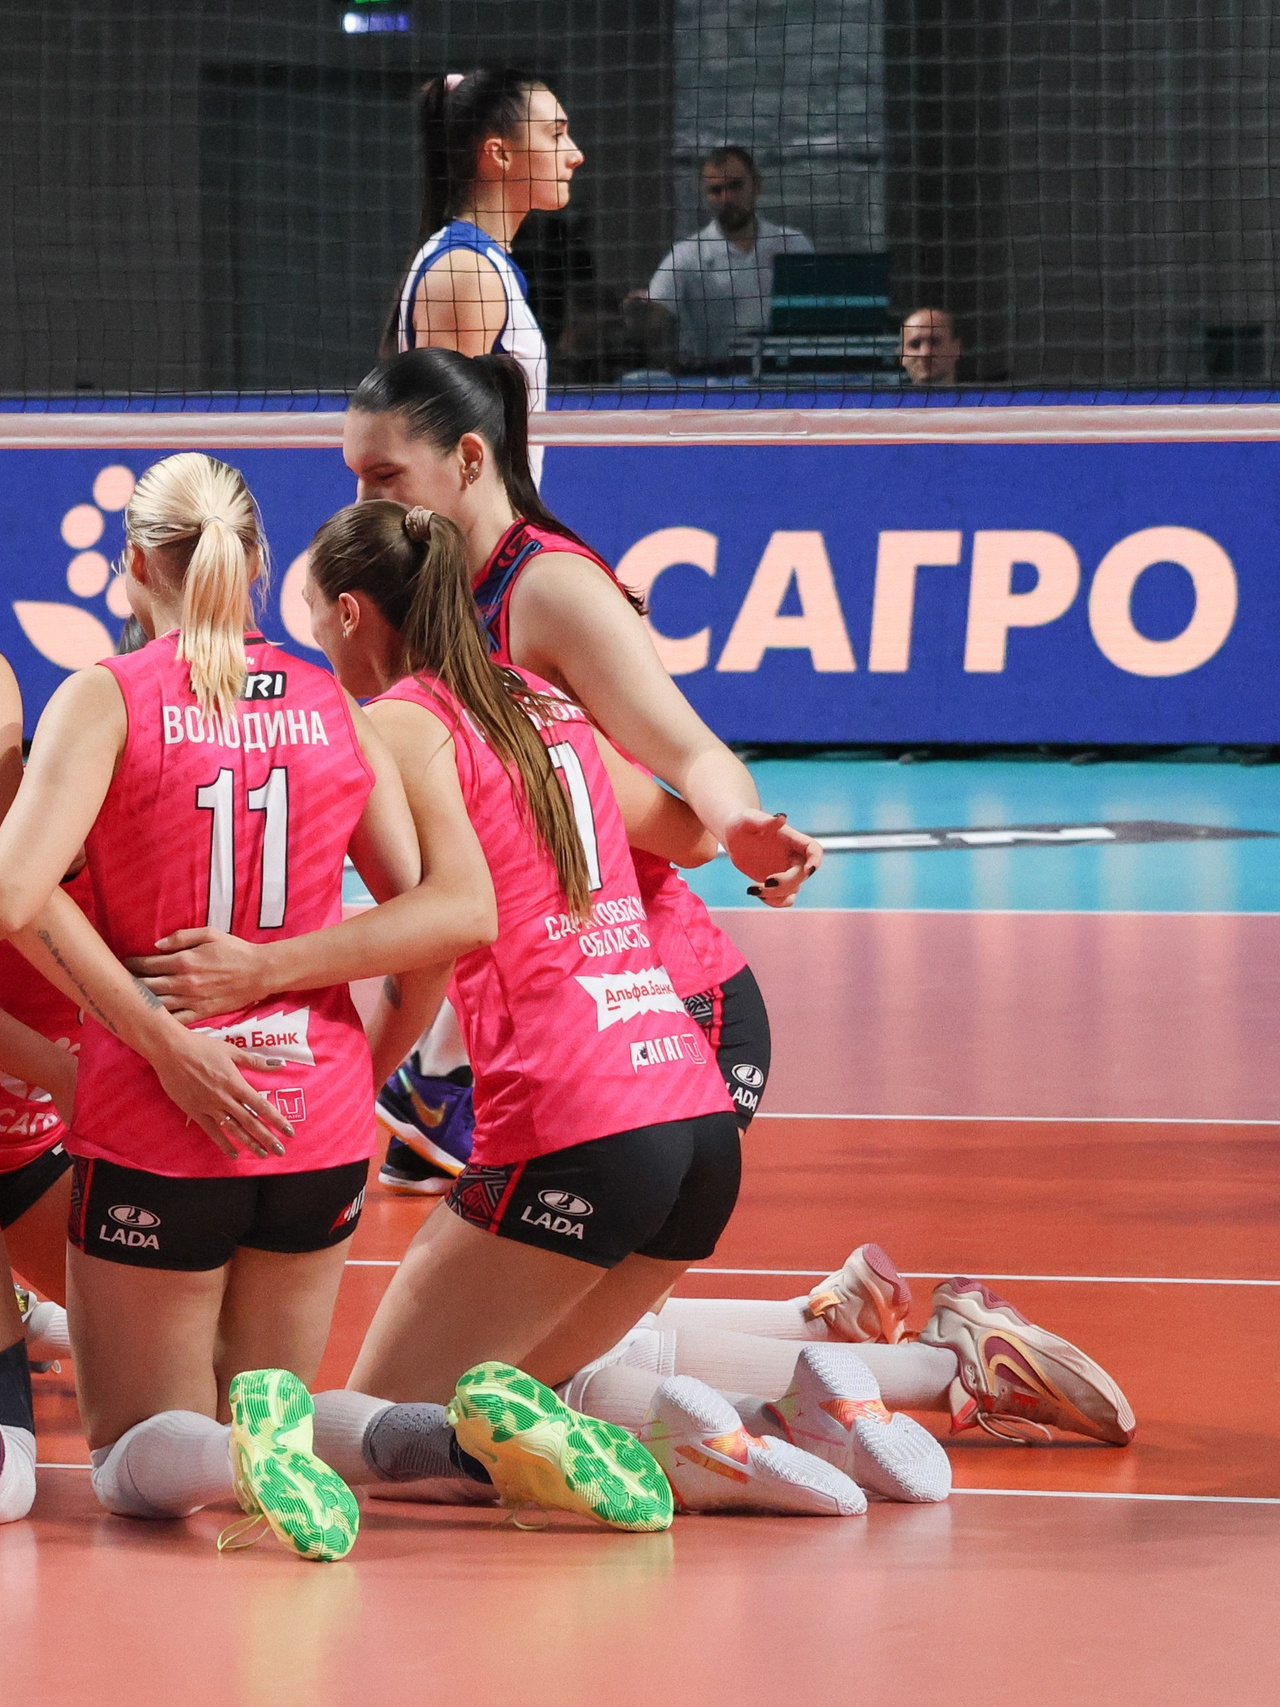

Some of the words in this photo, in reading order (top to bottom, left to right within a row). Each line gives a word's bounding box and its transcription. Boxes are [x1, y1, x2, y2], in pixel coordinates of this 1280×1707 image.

[280, 526, 1238, 677] САГРО
[162, 705, 329, 753] ВОЛОДИНА
[195, 766, 289, 934] 11
[251, 1031, 299, 1048] Банк
[99, 1224, 160, 1250] LADA
[521, 1205, 584, 1240] LADA
